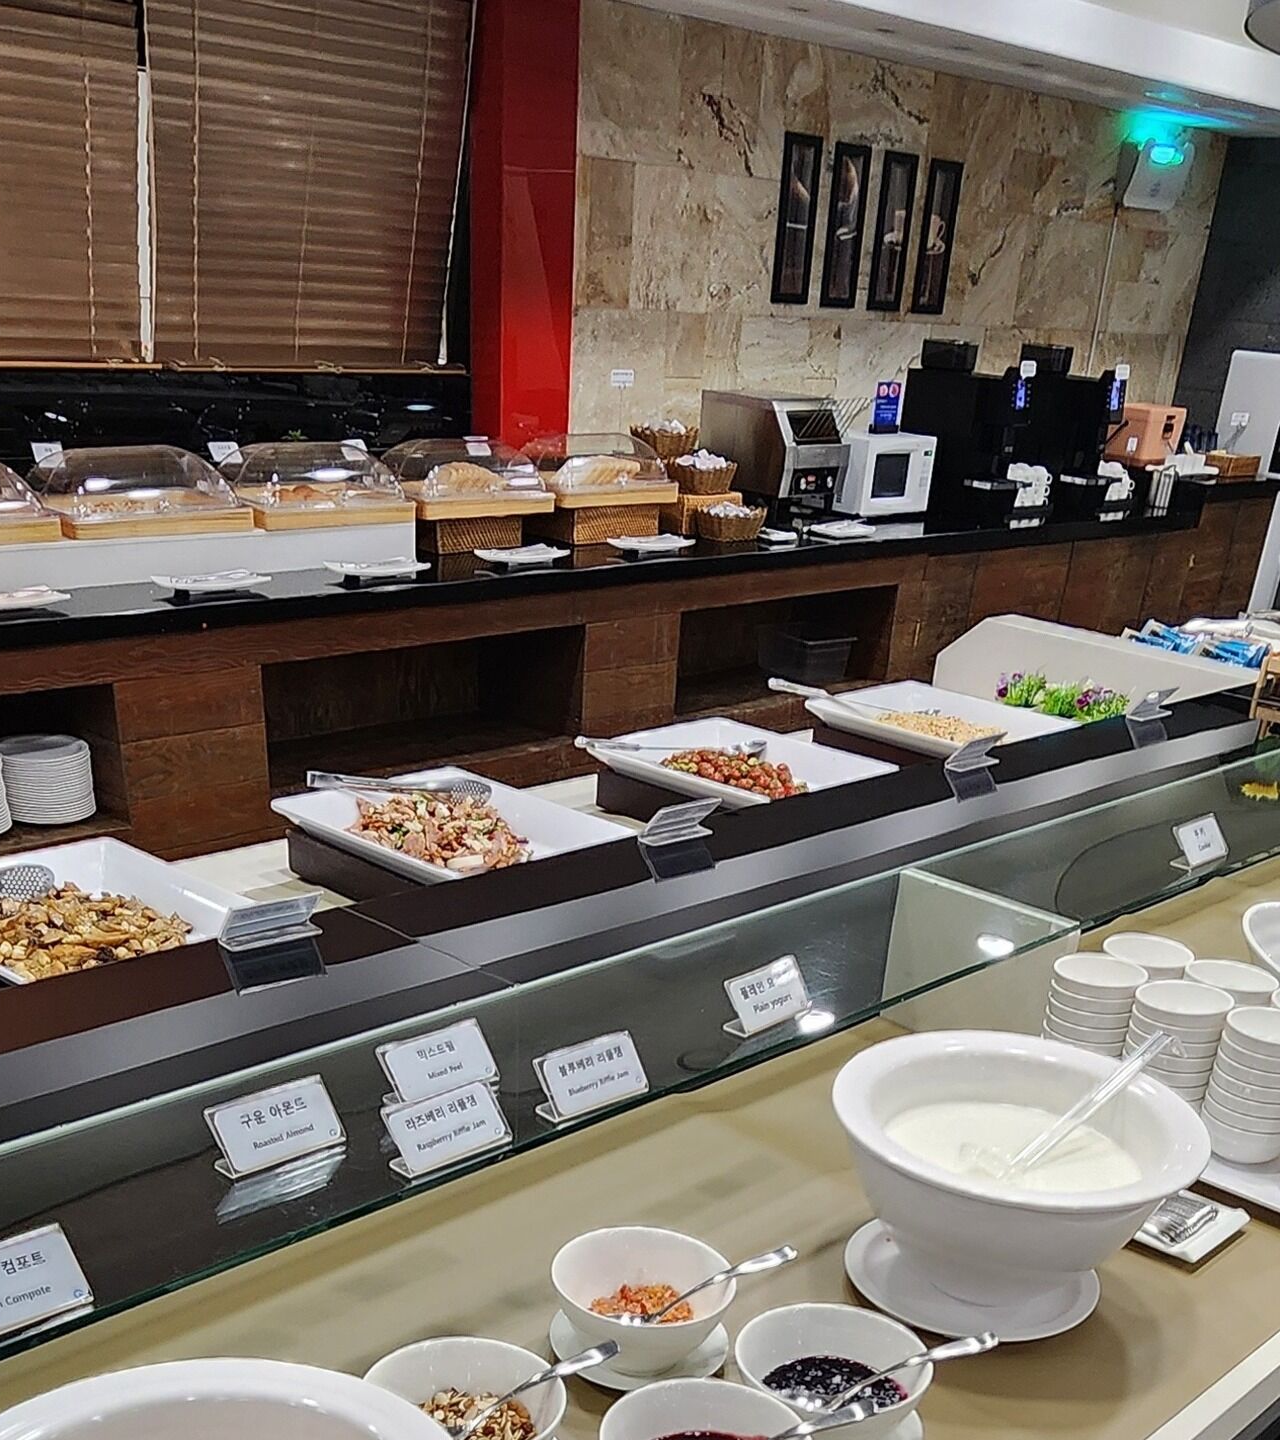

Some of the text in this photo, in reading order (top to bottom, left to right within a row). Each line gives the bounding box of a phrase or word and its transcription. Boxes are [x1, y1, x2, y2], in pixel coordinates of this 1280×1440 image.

[740, 981, 765, 1000] 플레인
[752, 993, 793, 1014] Plain yogurt
[416, 1040, 456, 1060] 믹스드필
[427, 1062, 464, 1080] Mixed Peel
[568, 1081, 599, 1097] Blueberry
[240, 1097, 308, 1129] 구운 아몬드
[405, 1094, 478, 1130] 라즈베리 리플잼
[253, 1123, 314, 1150] Roasted Almond
[417, 1133, 453, 1152] Raspberry
[472, 1119, 487, 1130] Jam
[1, 1250, 47, 1276] 컴포트
[5, 1284, 52, 1307] Compote
